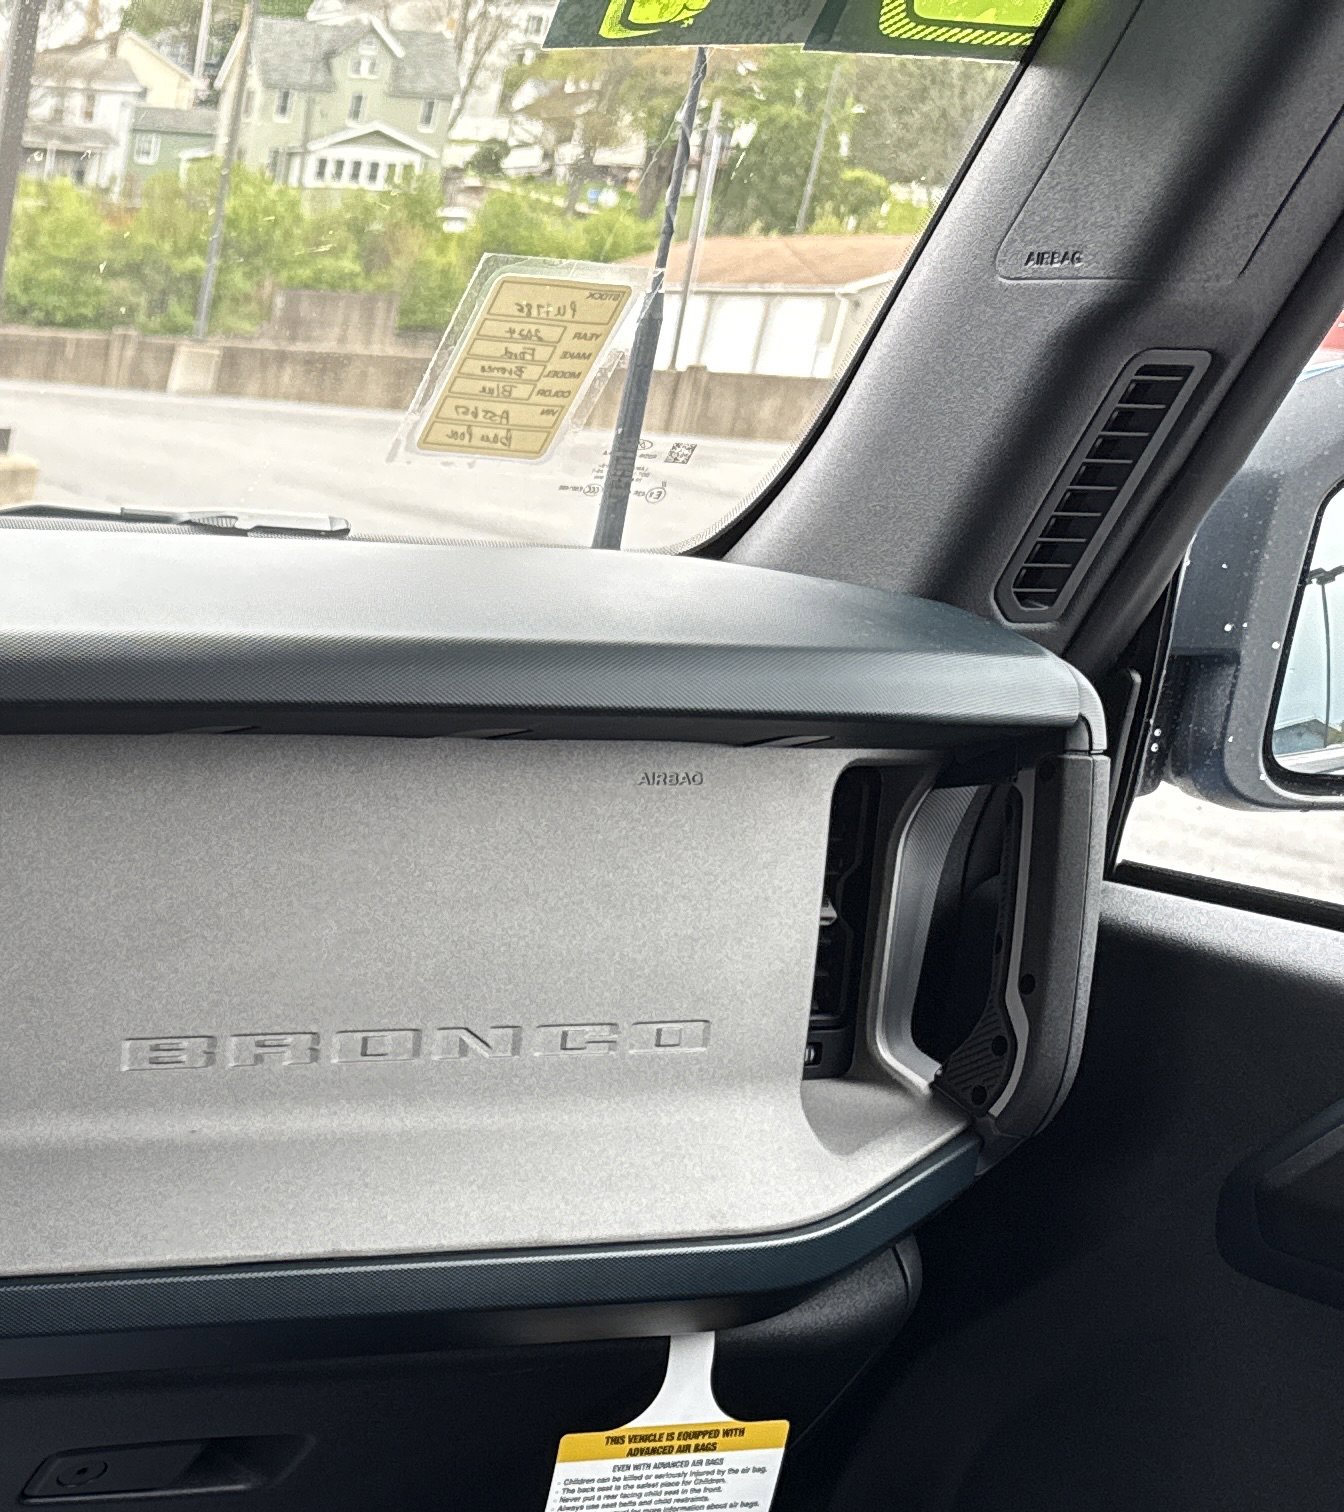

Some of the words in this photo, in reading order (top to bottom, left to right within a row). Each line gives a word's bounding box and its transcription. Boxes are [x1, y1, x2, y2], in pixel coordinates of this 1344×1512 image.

[1024, 251, 1084, 266] AIRBAG
[638, 771, 705, 787] AIRBAG
[118, 1019, 711, 1072] BRONCO
[605, 1434, 626, 1446] THIS
[628, 1432, 663, 1444] VEHICLE
[666, 1431, 675, 1441] IS
[677, 1429, 720, 1441] EQUIPPED
[722, 1427, 746, 1438] WITH
[626, 1445, 674, 1457] ADVANCED
[676, 1443, 692, 1455] AIR
[694, 1442, 718, 1453] BAGS
[612, 1463, 631, 1473] EVEN
[633, 1462, 652, 1471] WITH
[653, 1459, 690, 1470] ADVANCED
[691, 1458, 704, 1468] AIR
[705, 1457, 725, 1467] BAGS
